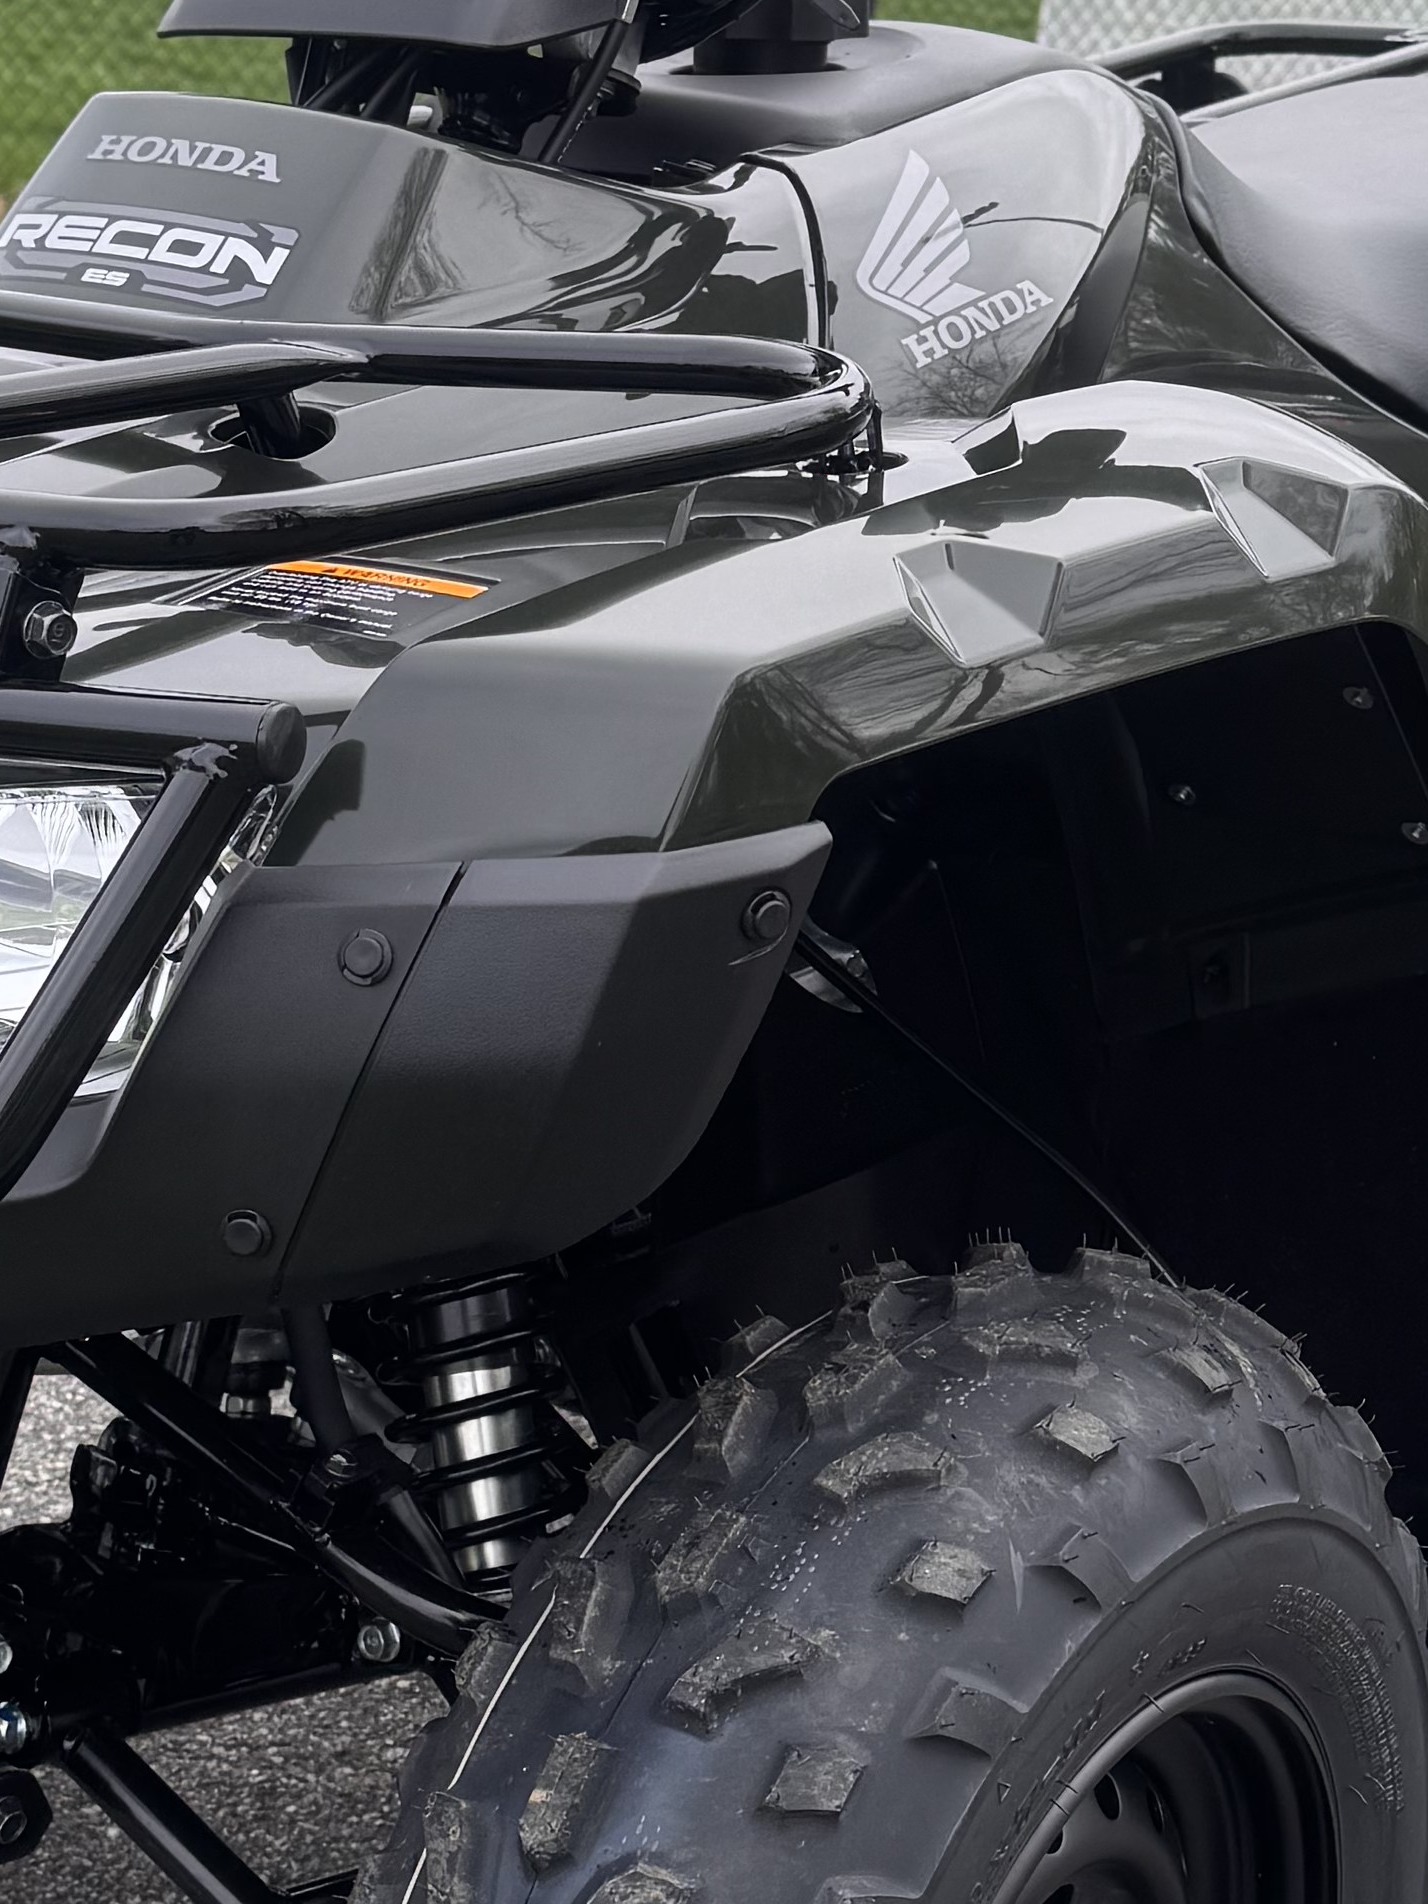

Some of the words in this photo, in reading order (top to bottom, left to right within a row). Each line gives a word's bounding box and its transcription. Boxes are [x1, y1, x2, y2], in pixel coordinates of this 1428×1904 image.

[86, 134, 281, 183] HONDA
[80, 268, 130, 286] ES
[900, 279, 1054, 369] HONDA
